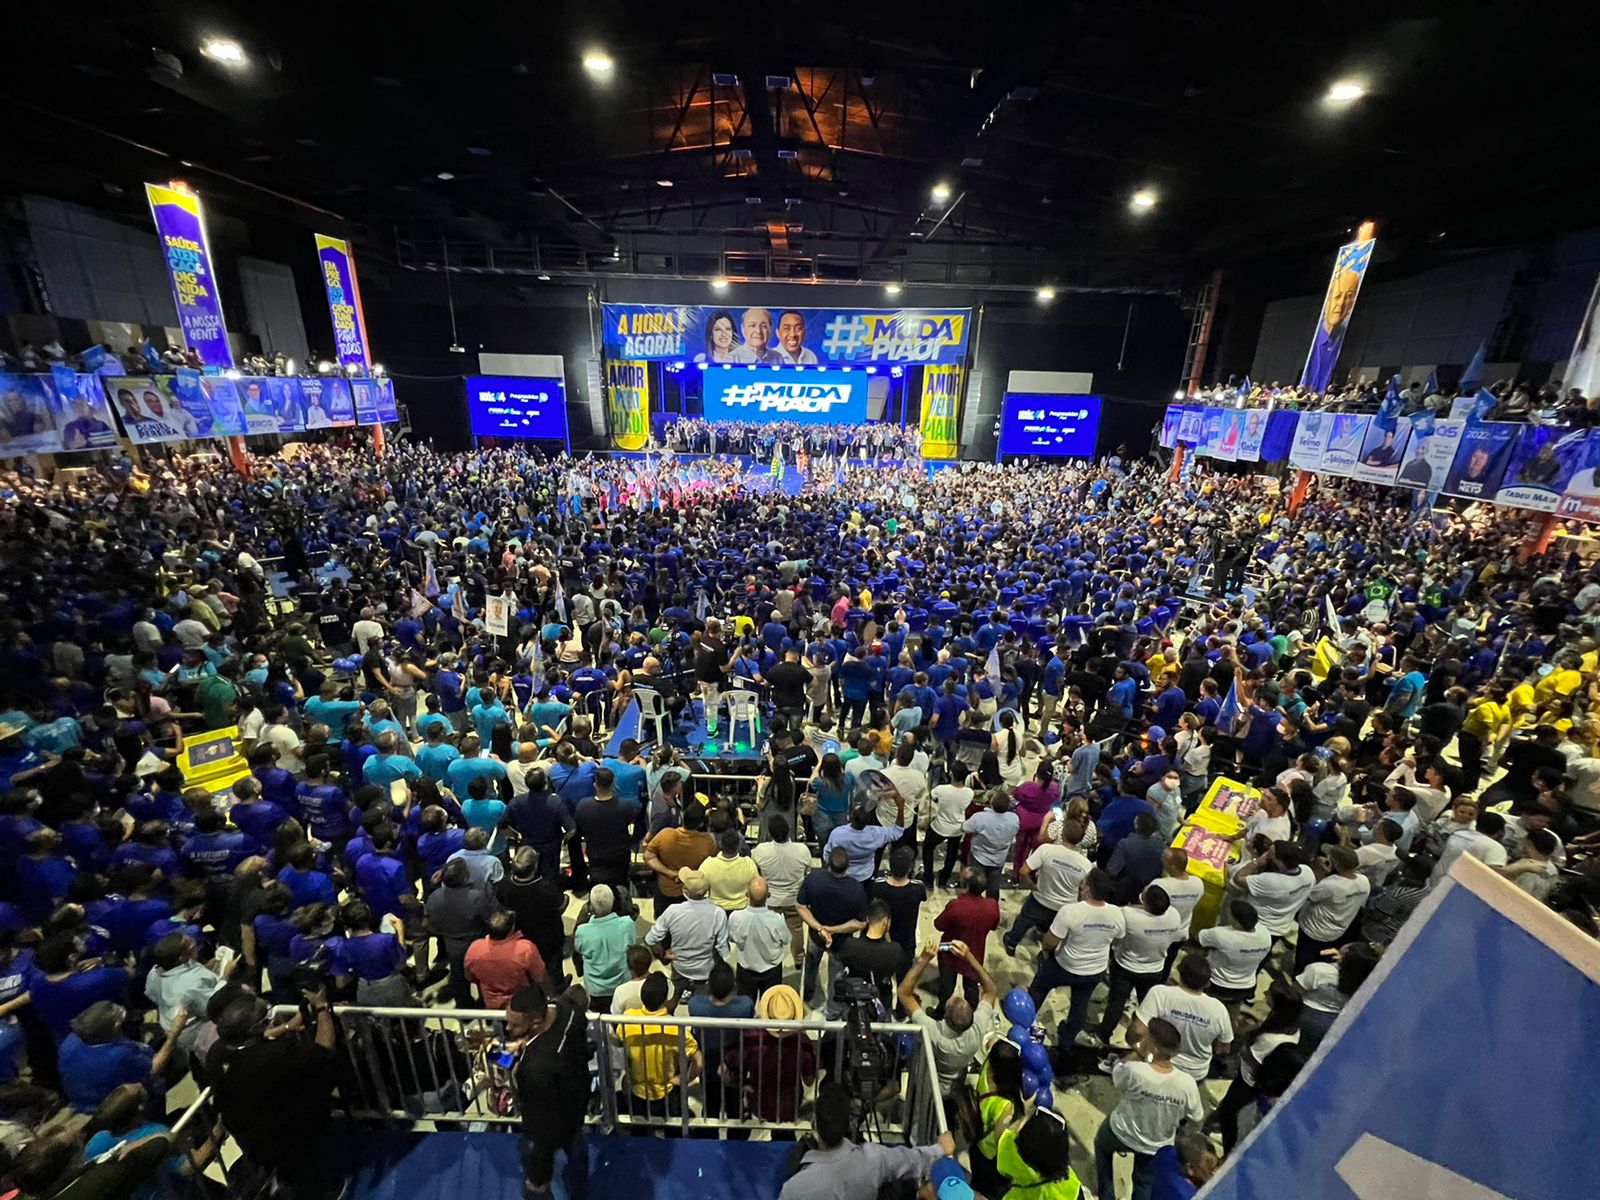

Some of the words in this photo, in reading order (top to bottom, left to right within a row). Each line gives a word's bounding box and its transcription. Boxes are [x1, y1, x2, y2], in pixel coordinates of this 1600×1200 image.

[173, 271, 197, 284] DIG
[175, 282, 208, 297] NIDA
[178, 294, 197, 305] DE
[192, 315, 220, 329] NOSSA
[617, 314, 628, 335] A
[632, 312, 674, 334] HORA
[189, 327, 220, 341] GENTE
[338, 342, 362, 357] TODOS
[625, 335, 681, 356] AGORA!
[609, 365, 645, 388] AMOR
[135, 422, 173, 432] DANIEL
[139, 427, 180, 439] PEREIRA
[1505, 490, 1530, 499] TADEU
